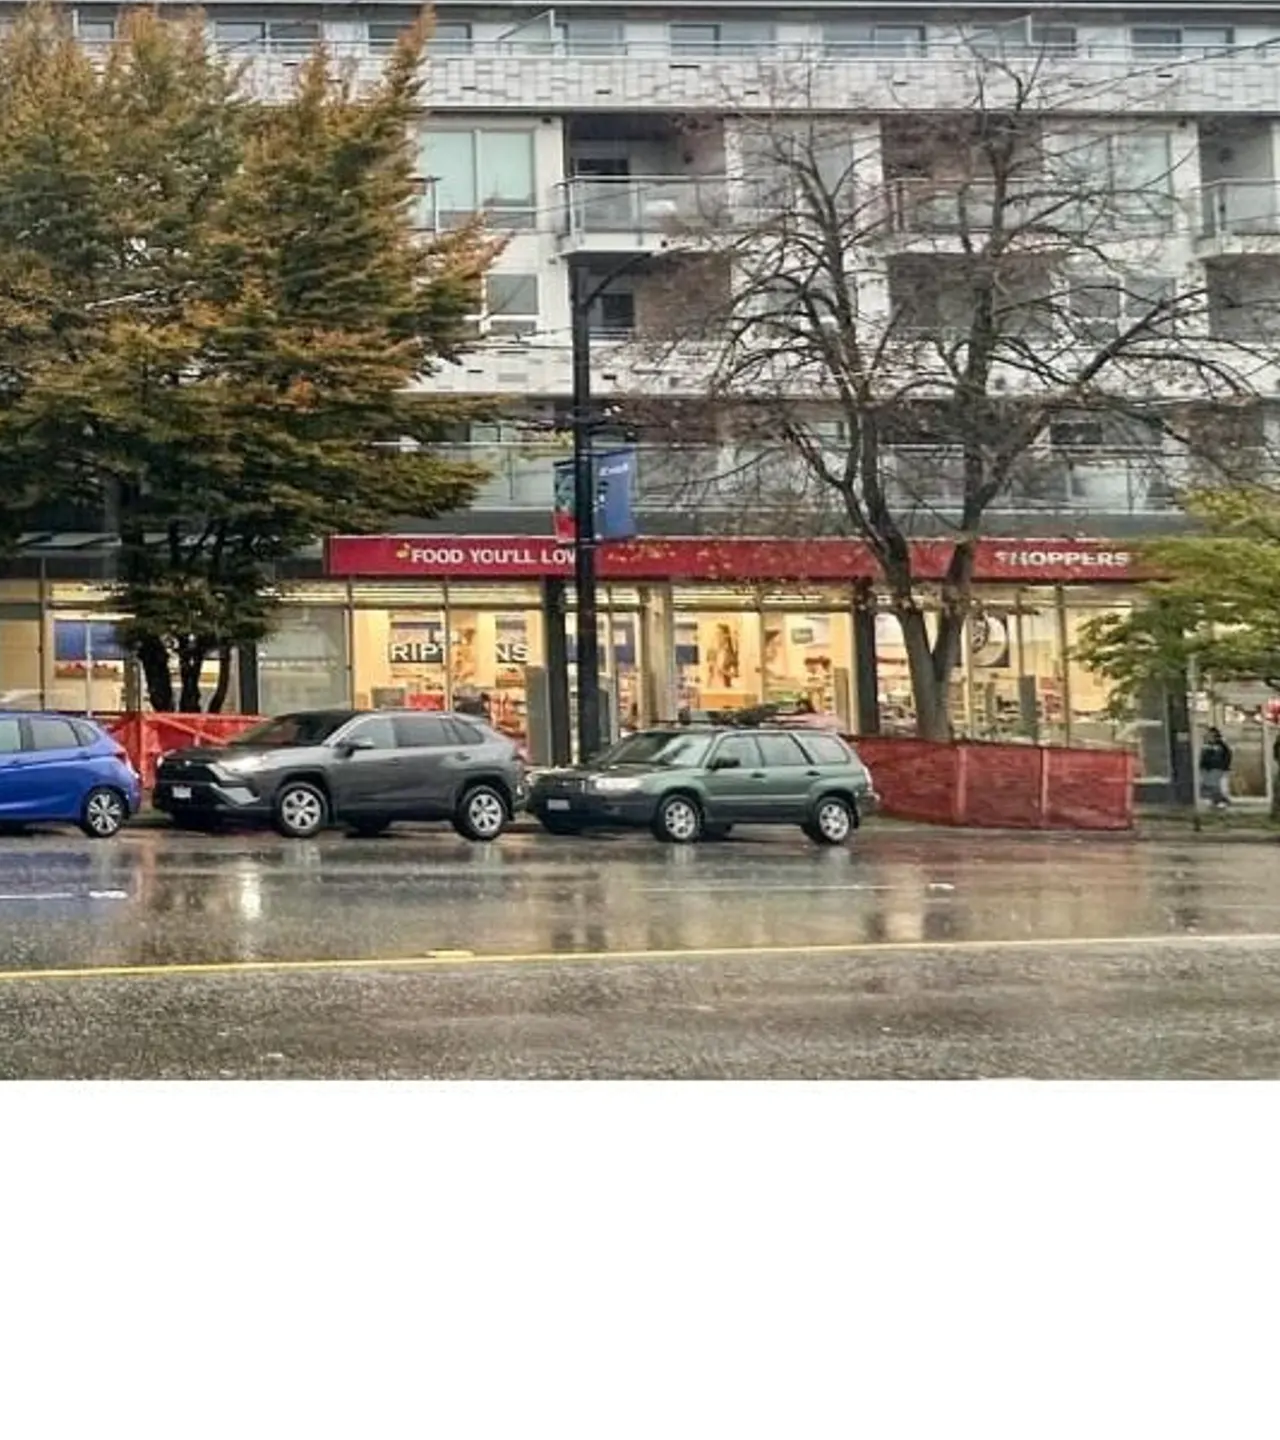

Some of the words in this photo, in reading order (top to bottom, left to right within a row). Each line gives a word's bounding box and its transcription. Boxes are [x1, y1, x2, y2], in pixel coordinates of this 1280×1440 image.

[411, 549, 464, 564] FOOD
[469, 549, 537, 564] YOU'LL
[541, 549, 576, 564] LOV
